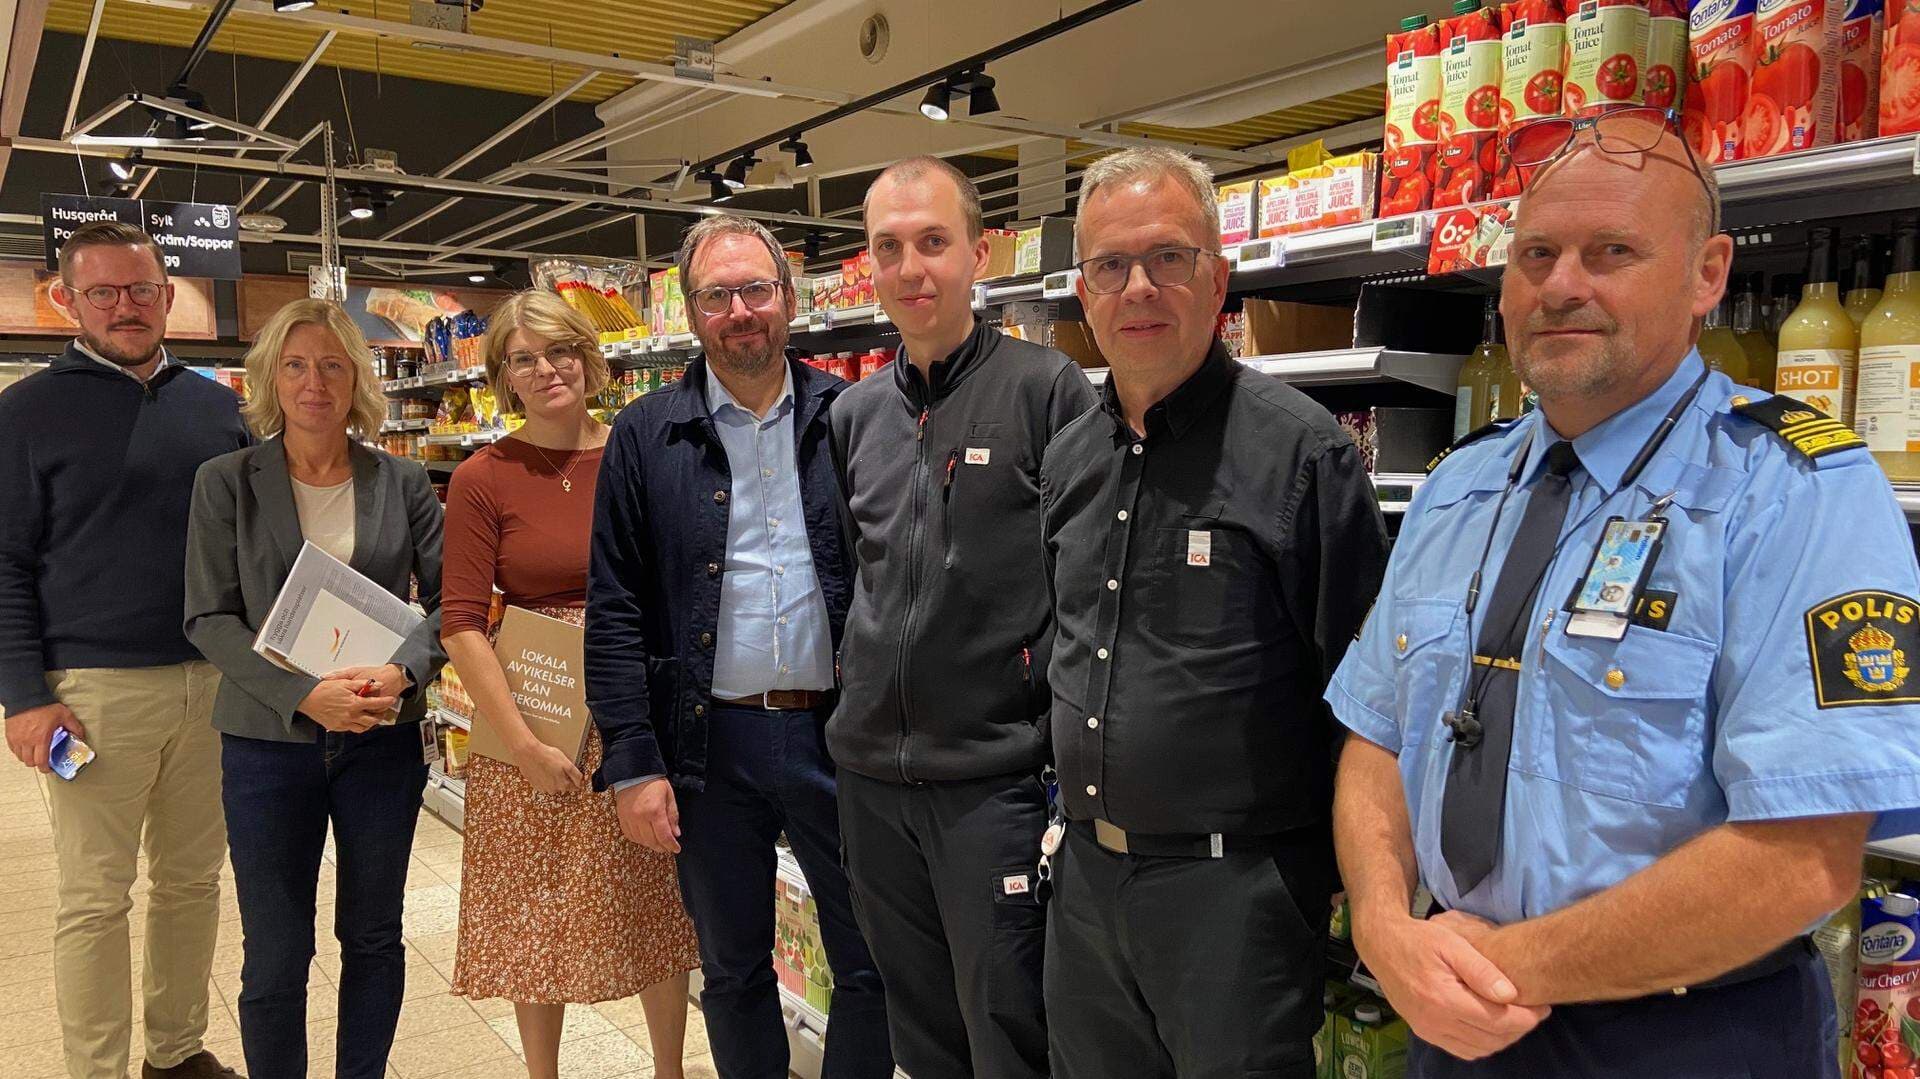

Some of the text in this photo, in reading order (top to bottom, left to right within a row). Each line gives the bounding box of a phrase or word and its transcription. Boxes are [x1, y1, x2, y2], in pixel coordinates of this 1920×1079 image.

[1763, 4, 1812, 40] Tomato
[1574, 23, 1605, 39] Tomat
[1505, 41, 1531, 57] Tomat
[1574, 37, 1599, 54] juice
[1695, 24, 1742, 58] Tomato
[1446, 57, 1472, 72] Tomat
[1506, 55, 1528, 71] juice
[1393, 71, 1419, 86] Tomat
[1446, 70, 1468, 85] juice
[1393, 83, 1416, 98] juice
[1328, 192, 1353, 209] JUICE
[52, 207, 117, 222] Husgeråd
[1266, 210, 1288, 225] JUICE
[1295, 203, 1318, 219] JUICE
[151, 214, 173, 228] Sylt
[1223, 216, 1245, 230] JUICE
[152, 234, 233, 250] Kräm/Soppor
[163, 256, 181, 268] gg
[1780, 370, 1833, 386] SHOT
[969, 452, 984, 462] ICA
[1191, 553, 1207, 563] ICA
[1819, 597, 1915, 631] POLIS
[521, 648, 567, 672] LOKALA
[507, 660, 576, 689] AVVIKELSER
[522, 680, 551, 697] KAN
[1009, 882, 1024, 891] ICA
[1861, 935, 1906, 951] Fontana
[1859, 968, 1919, 988] our Cherry
